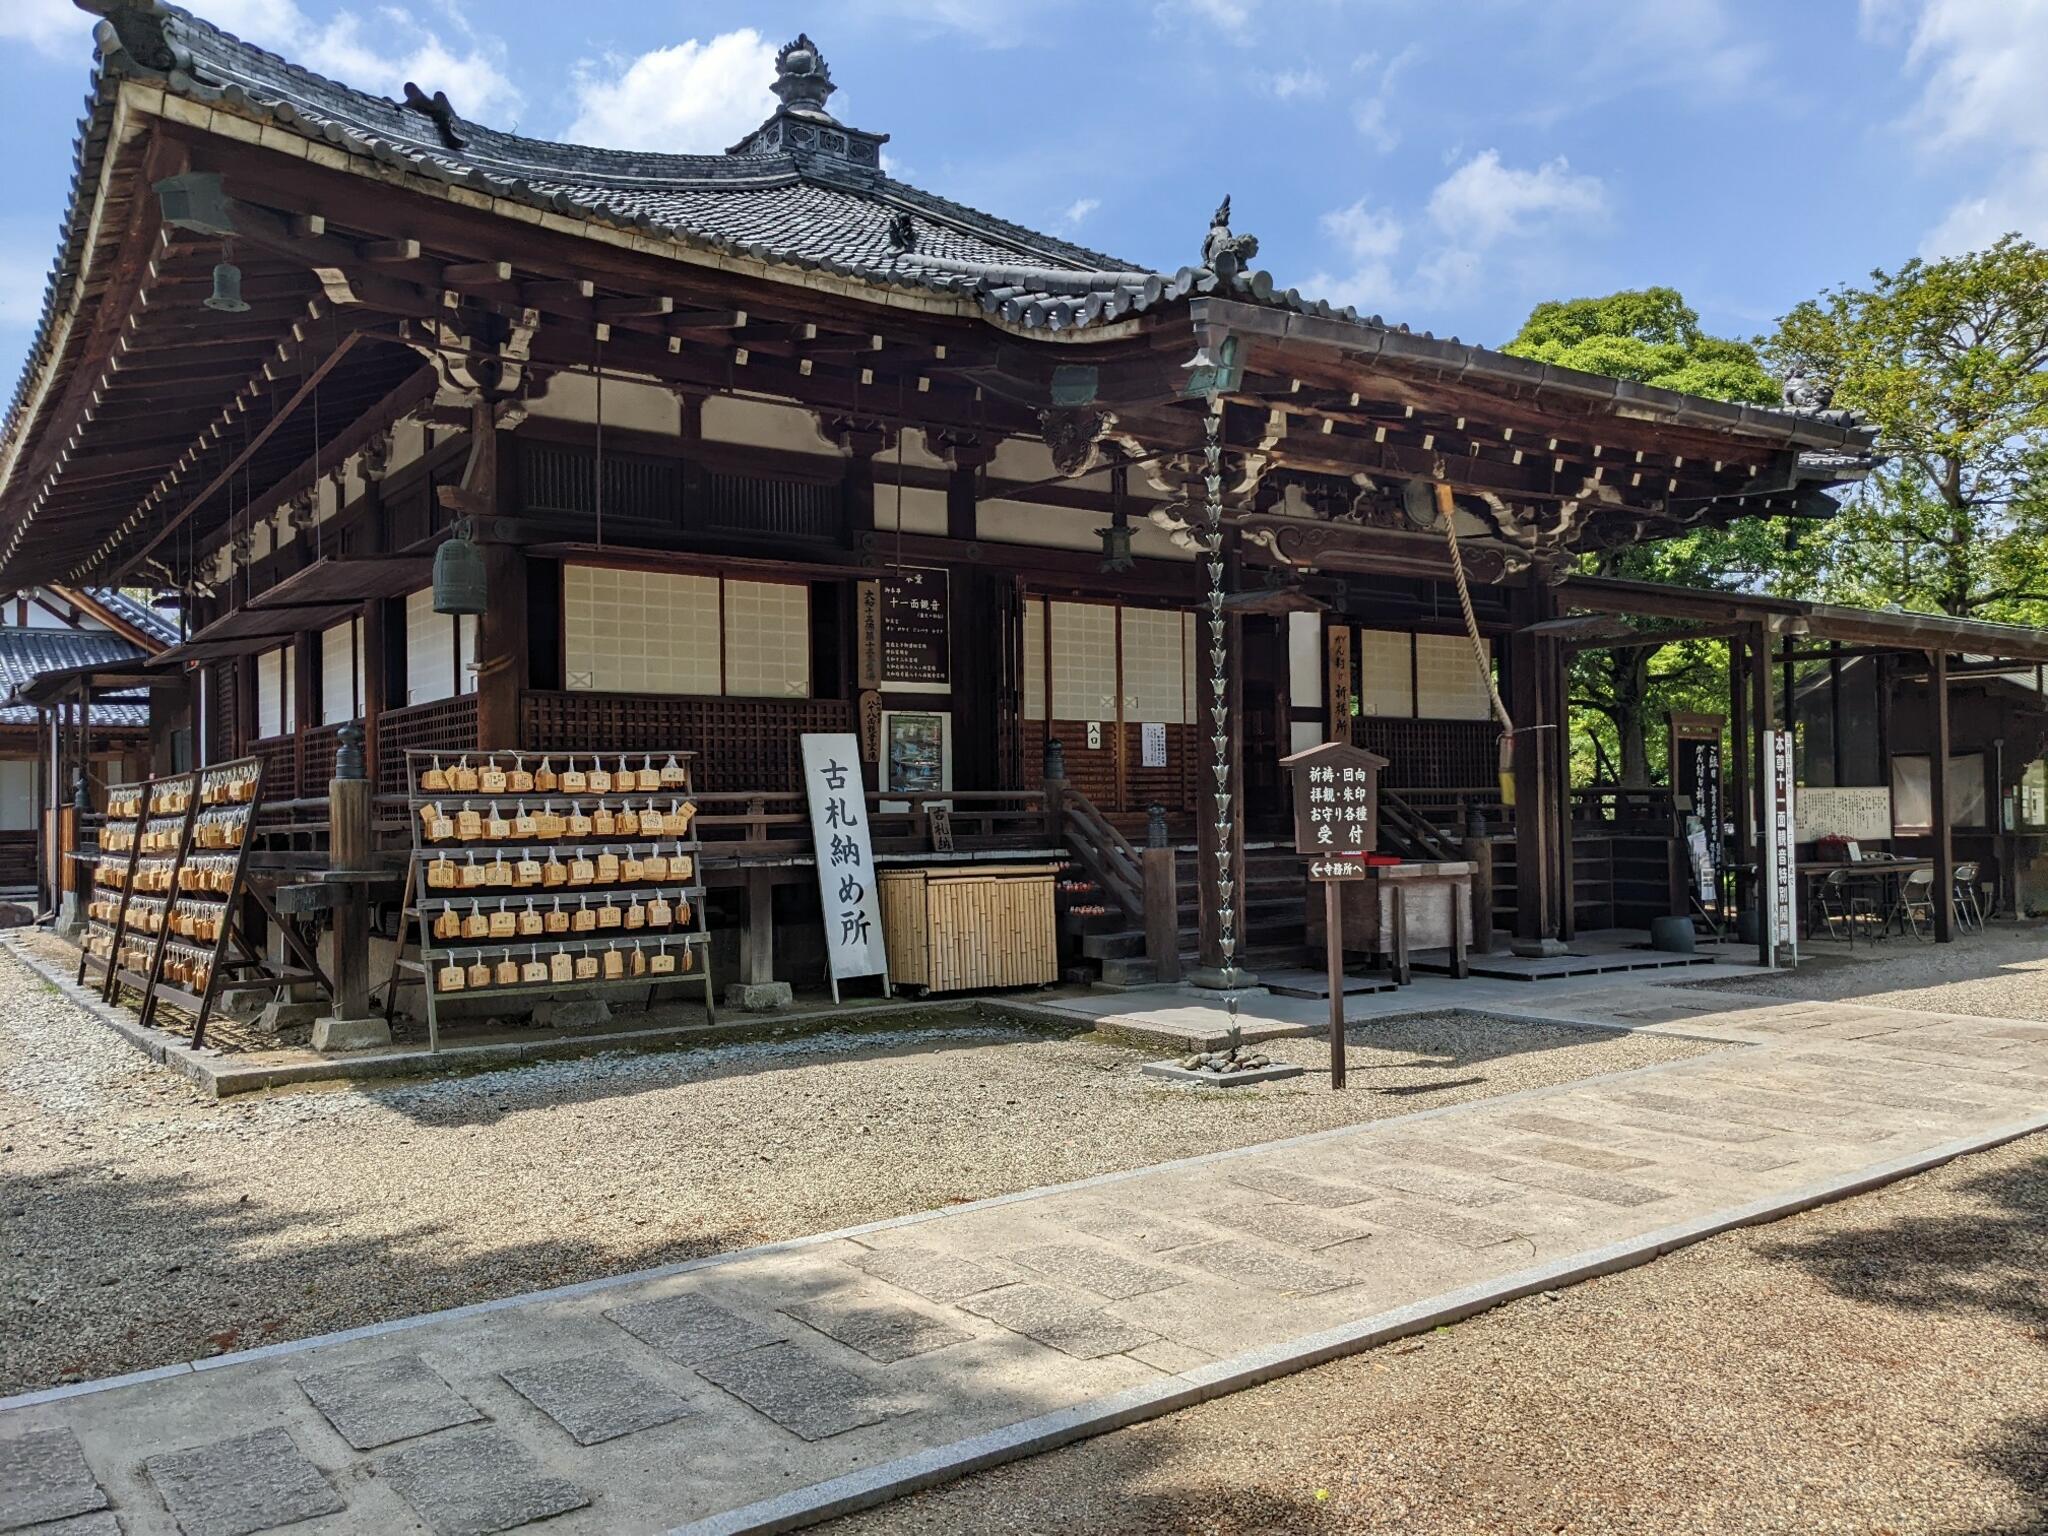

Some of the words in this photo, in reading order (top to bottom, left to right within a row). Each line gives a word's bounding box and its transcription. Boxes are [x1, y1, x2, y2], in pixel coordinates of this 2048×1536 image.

[890, 597, 940, 611] 十一面観音
[1089, 725, 1099, 744] 入口
[1310, 786, 1366, 803] 拝観・朱印
[1310, 805, 1368, 822] お守り各種
[1317, 824, 1364, 845] 受付
[819, 758, 871, 946] 古札納め所
[1323, 861, 1363, 876] 寺務所へ
